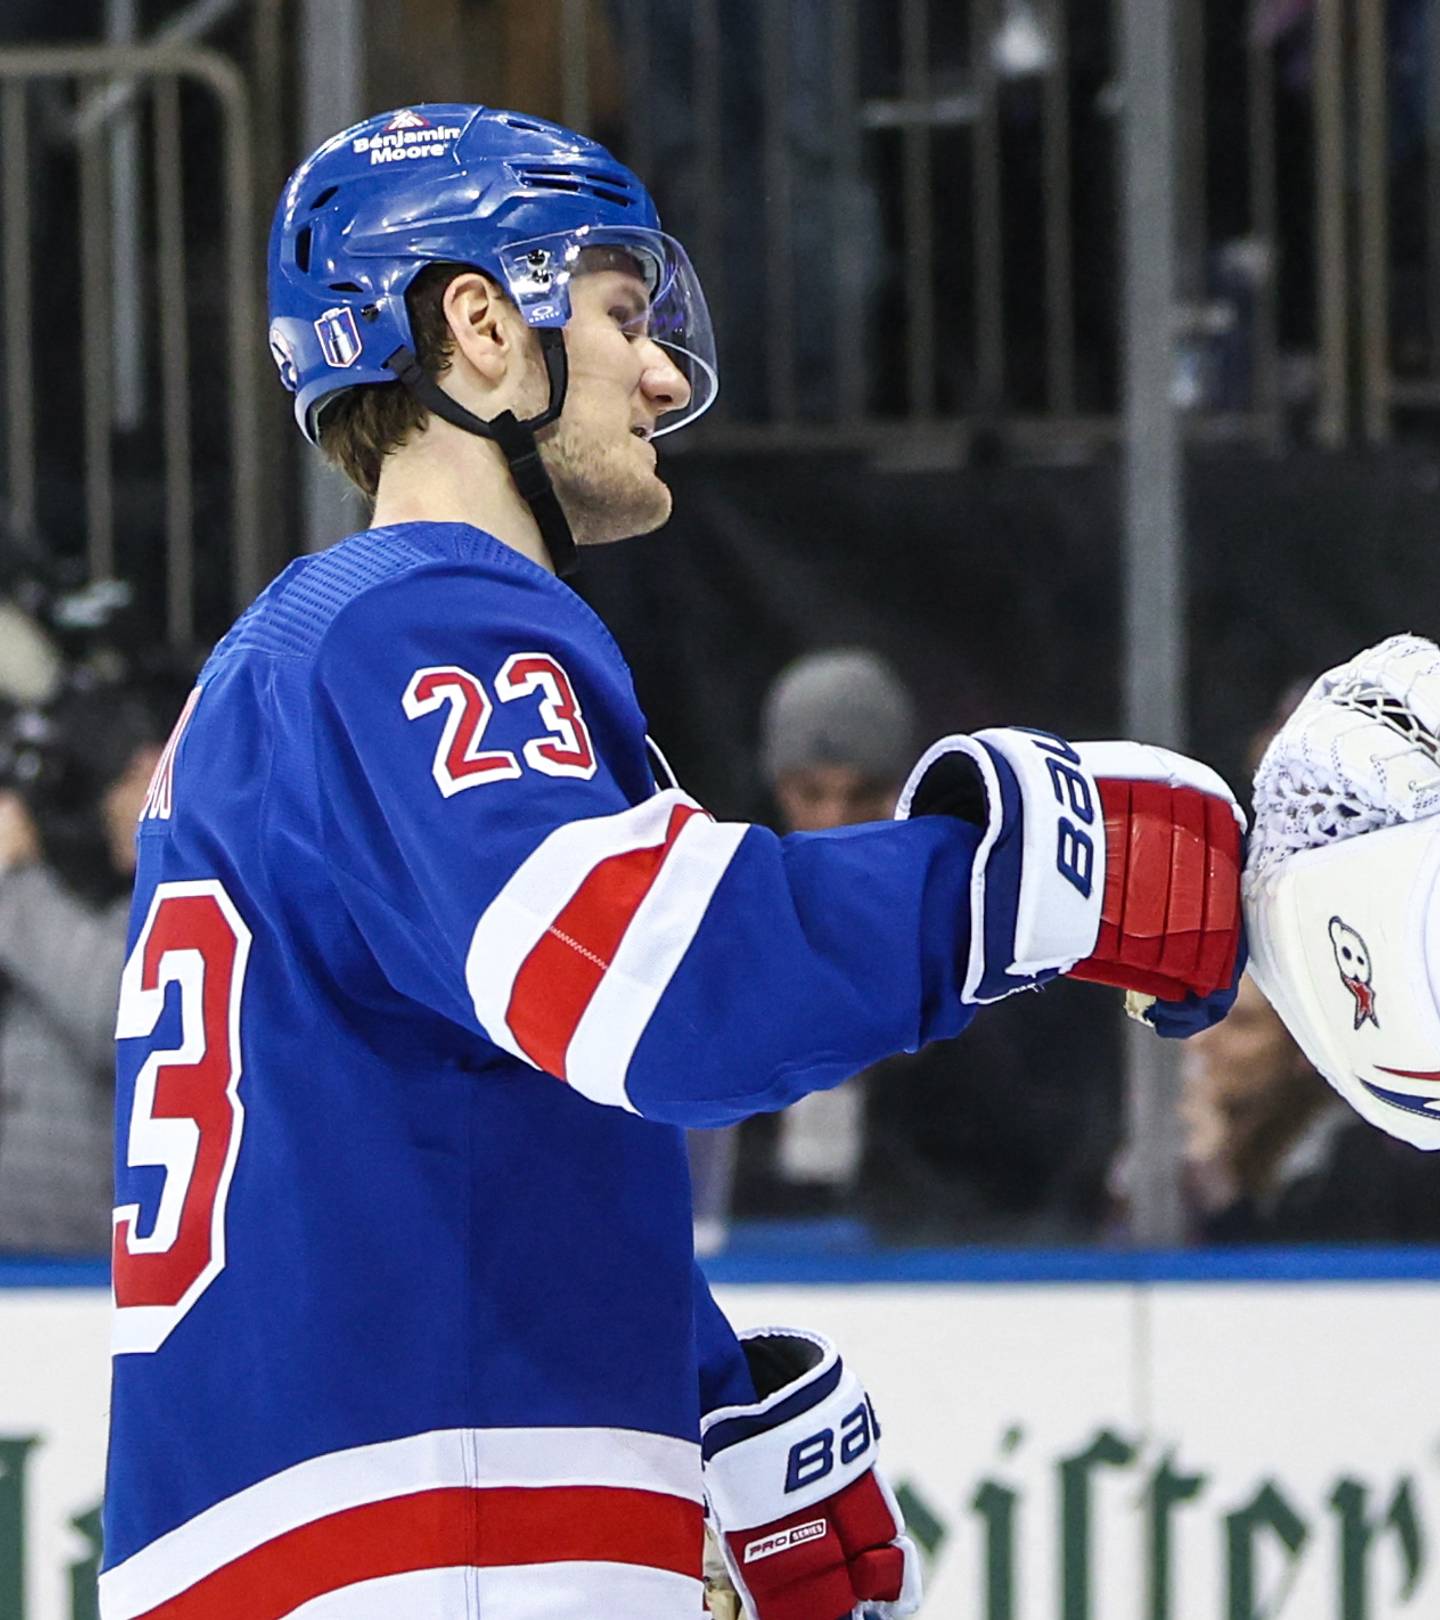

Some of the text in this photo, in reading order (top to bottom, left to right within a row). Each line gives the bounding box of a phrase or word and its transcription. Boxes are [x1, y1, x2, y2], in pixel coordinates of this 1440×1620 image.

[370, 143, 446, 165] Moore
[401, 651, 598, 799] 23
[749, 1535, 788, 1558] PRO
